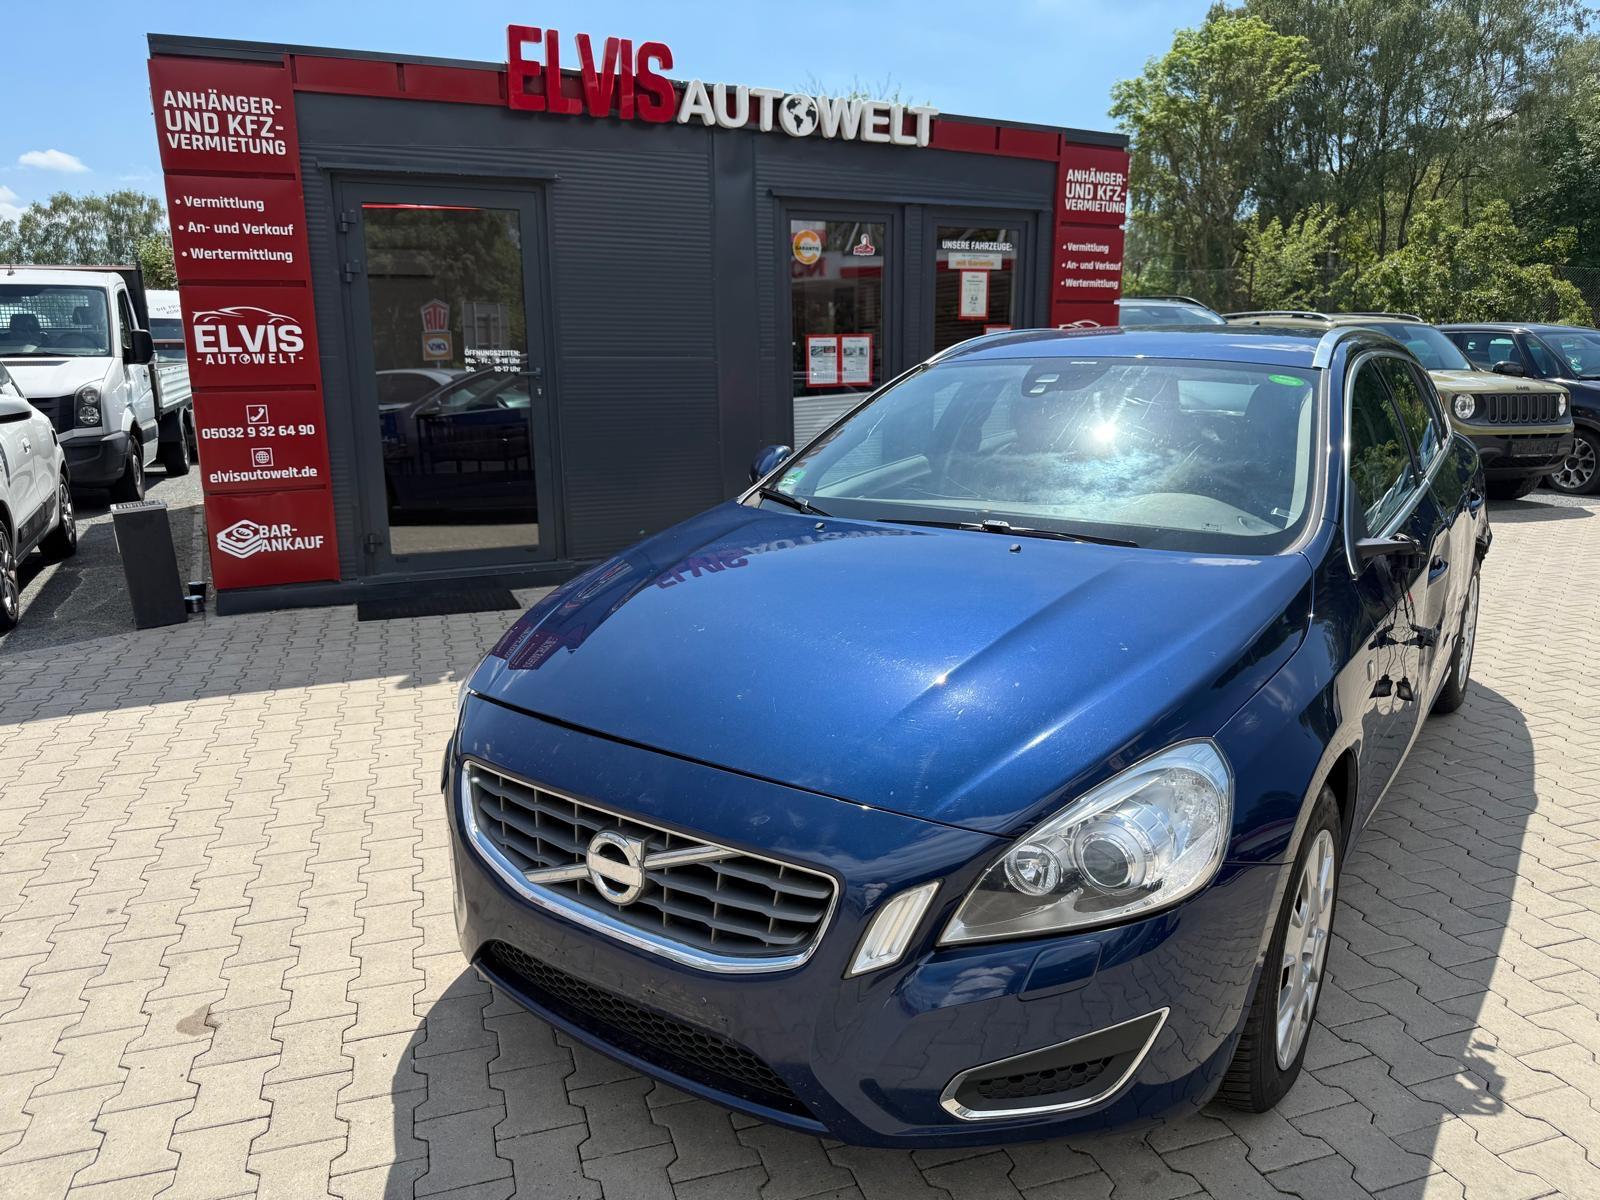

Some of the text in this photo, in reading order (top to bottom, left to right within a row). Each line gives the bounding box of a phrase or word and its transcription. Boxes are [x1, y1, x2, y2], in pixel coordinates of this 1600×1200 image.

[507, 24, 676, 123] ELVIS
[163, 89, 282, 115] ANHÄNGER-
[164, 109, 284, 138] UND KFZ-
[167, 133, 286, 156] VERMIETUNG
[1066, 168, 1127, 186] ANHÄNGER-
[1066, 183, 1126, 201] UND KFZ-
[184, 195, 265, 212] Vermittlung
[1065, 199, 1125, 214] VERMIETUNG
[188, 221, 294, 236] An- und Verkauf
[942, 240, 1013, 251] UNSERE FAHRZEUGE:
[1067, 242, 1110, 255] Vermittlung
[190, 247, 293, 263] Wertermittlung
[1066, 261, 1122, 271] An- und Verkauf
[1065, 278, 1119, 290] Wertermittlung
[193, 324, 304, 353] ELVIS
[464, 345, 520, 357] ÖFFNUNGSZEITEN:
[510, 365, 521, 373] Uhr
[201, 424, 315, 440] 05032 9 32 64 90
[209, 466, 318, 484] elvisautowelt.de
[258, 523, 298, 538] BAR-
[260, 535, 324, 551] ANKAUF
